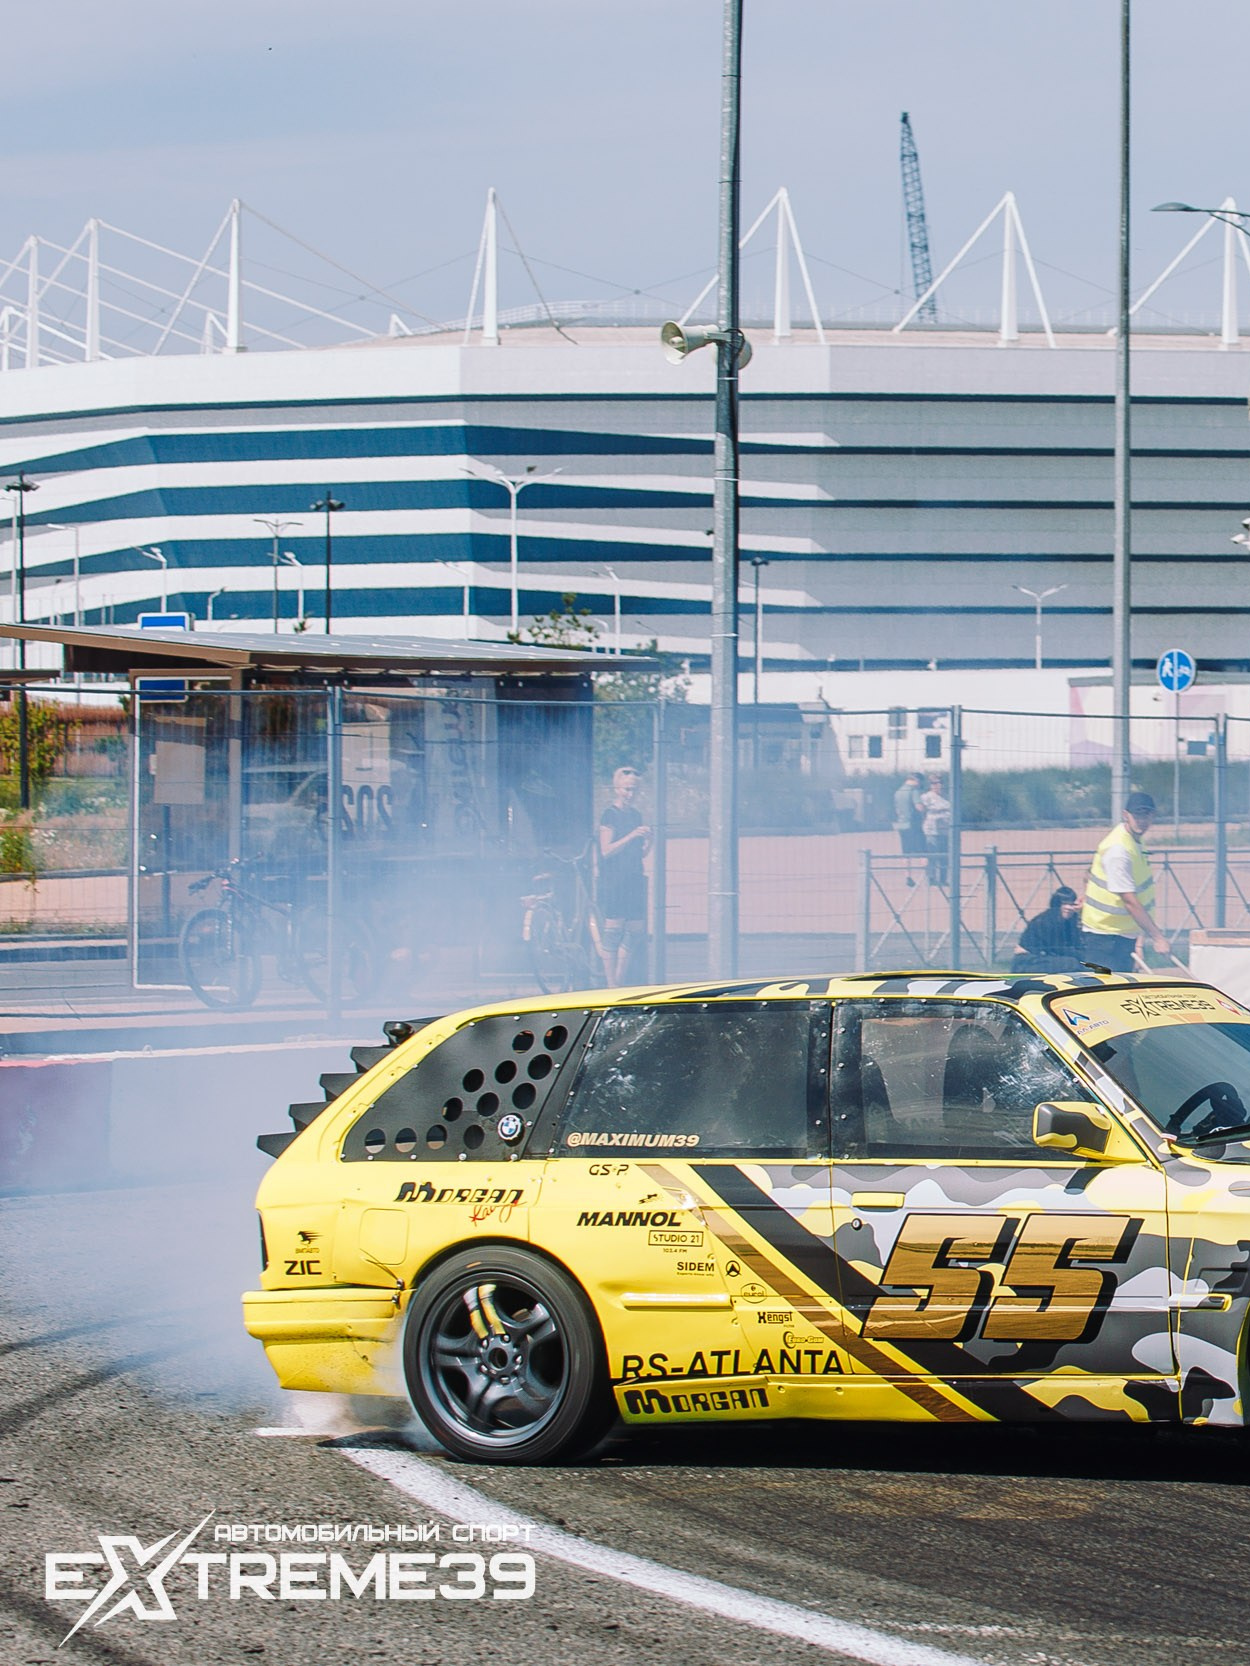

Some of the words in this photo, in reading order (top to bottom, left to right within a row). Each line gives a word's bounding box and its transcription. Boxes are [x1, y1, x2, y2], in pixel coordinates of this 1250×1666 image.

[567, 1132, 700, 1147] @MAXIMUM39
[576, 1212, 682, 1226] MANNOL
[653, 1234, 687, 1243] STUDIO
[690, 1235, 699, 1243] 21
[284, 1260, 322, 1275] ZIC
[676, 1261, 715, 1272] SIDEM
[858, 1213, 1145, 1344] 55
[757, 1311, 793, 1324] Hengst
[621, 1348, 845, 1379] RS-ATLANTA
